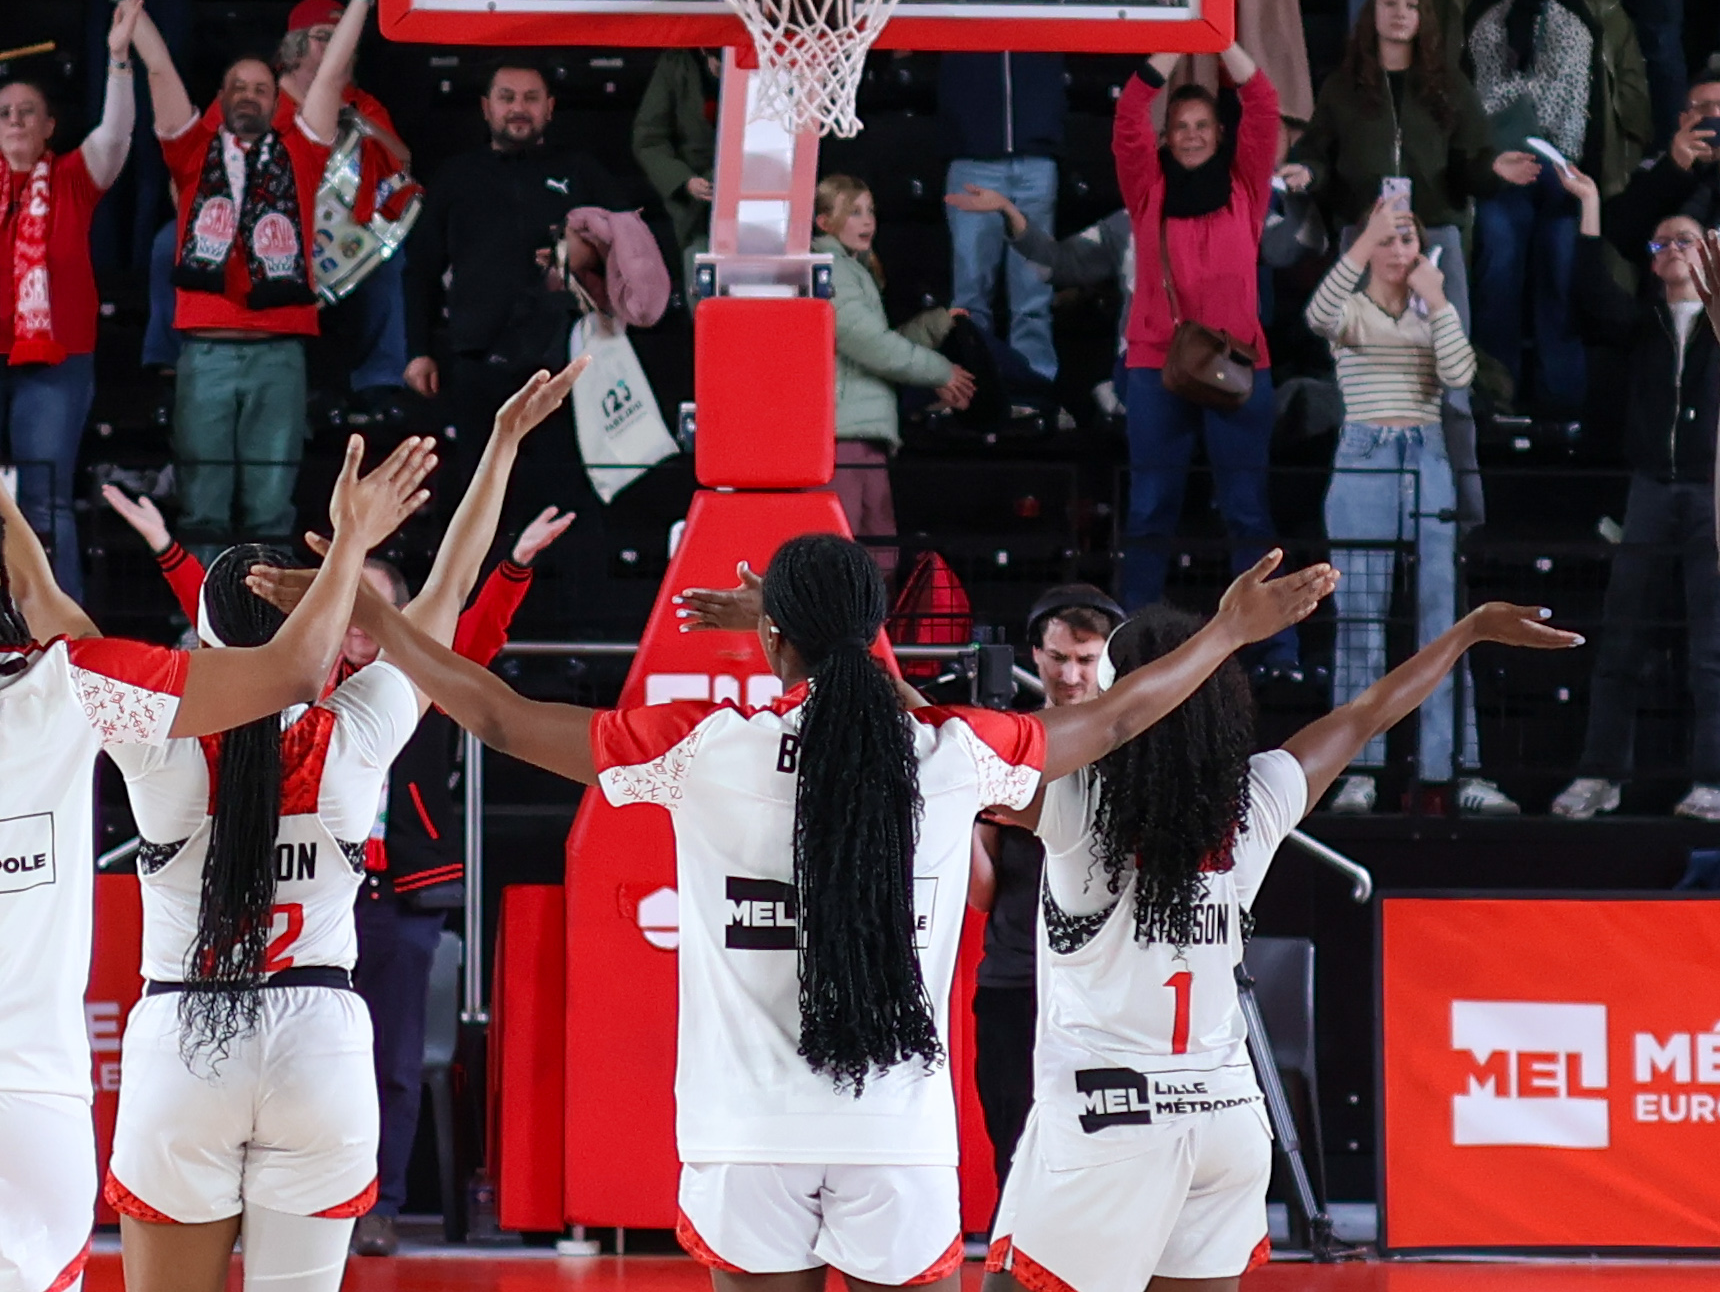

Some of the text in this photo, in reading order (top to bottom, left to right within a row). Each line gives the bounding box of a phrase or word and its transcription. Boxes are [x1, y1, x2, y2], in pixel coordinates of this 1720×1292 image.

[728, 899, 798, 928] MEL
[1162, 971, 1193, 1055] 1
[1457, 1048, 1609, 1100] MEL
[1076, 1087, 1152, 1117] MEL
